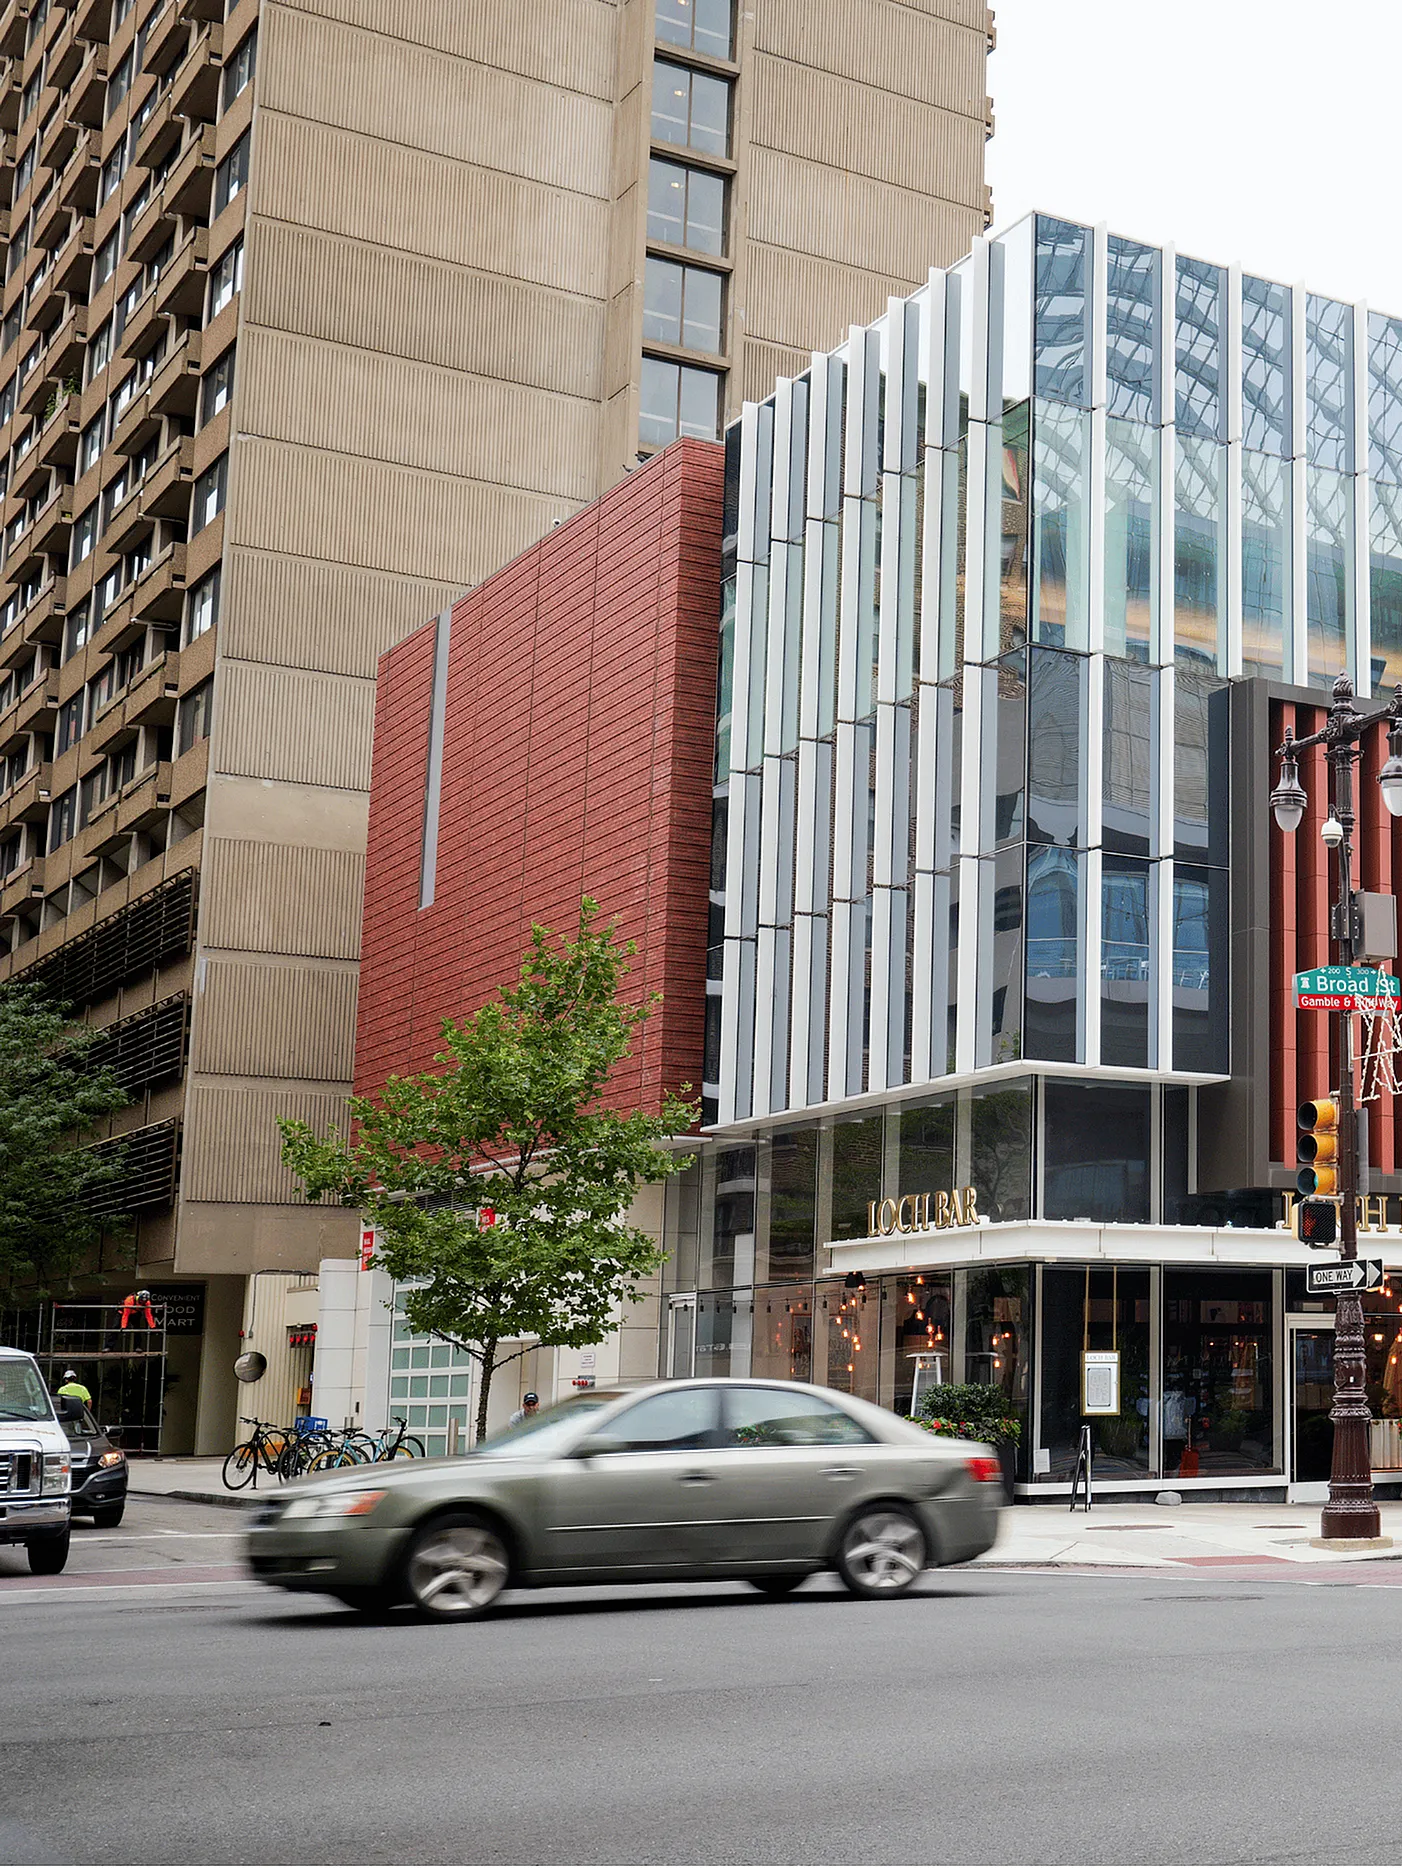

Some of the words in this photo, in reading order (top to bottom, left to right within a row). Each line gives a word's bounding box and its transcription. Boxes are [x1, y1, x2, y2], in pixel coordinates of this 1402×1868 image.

[1346, 967, 1352, 976] S
[1316, 976, 1368, 992] Broad
[1380, 978, 1396, 994] St
[1301, 996, 1340, 1008] Gamble
[1344, 998, 1350, 1007] &
[866, 1192, 930, 1237] LOCH
[934, 1186, 980, 1230] BAR
[1282, 1191, 1389, 1232] LH
[1316, 1270, 1334, 1284] ONE
[1336, 1268, 1353, 1282] WAY
[151, 1294, 200, 1302] CONVENIENT
[155, 1306, 196, 1314] FOOD
[154, 1317, 196, 1326] MART
